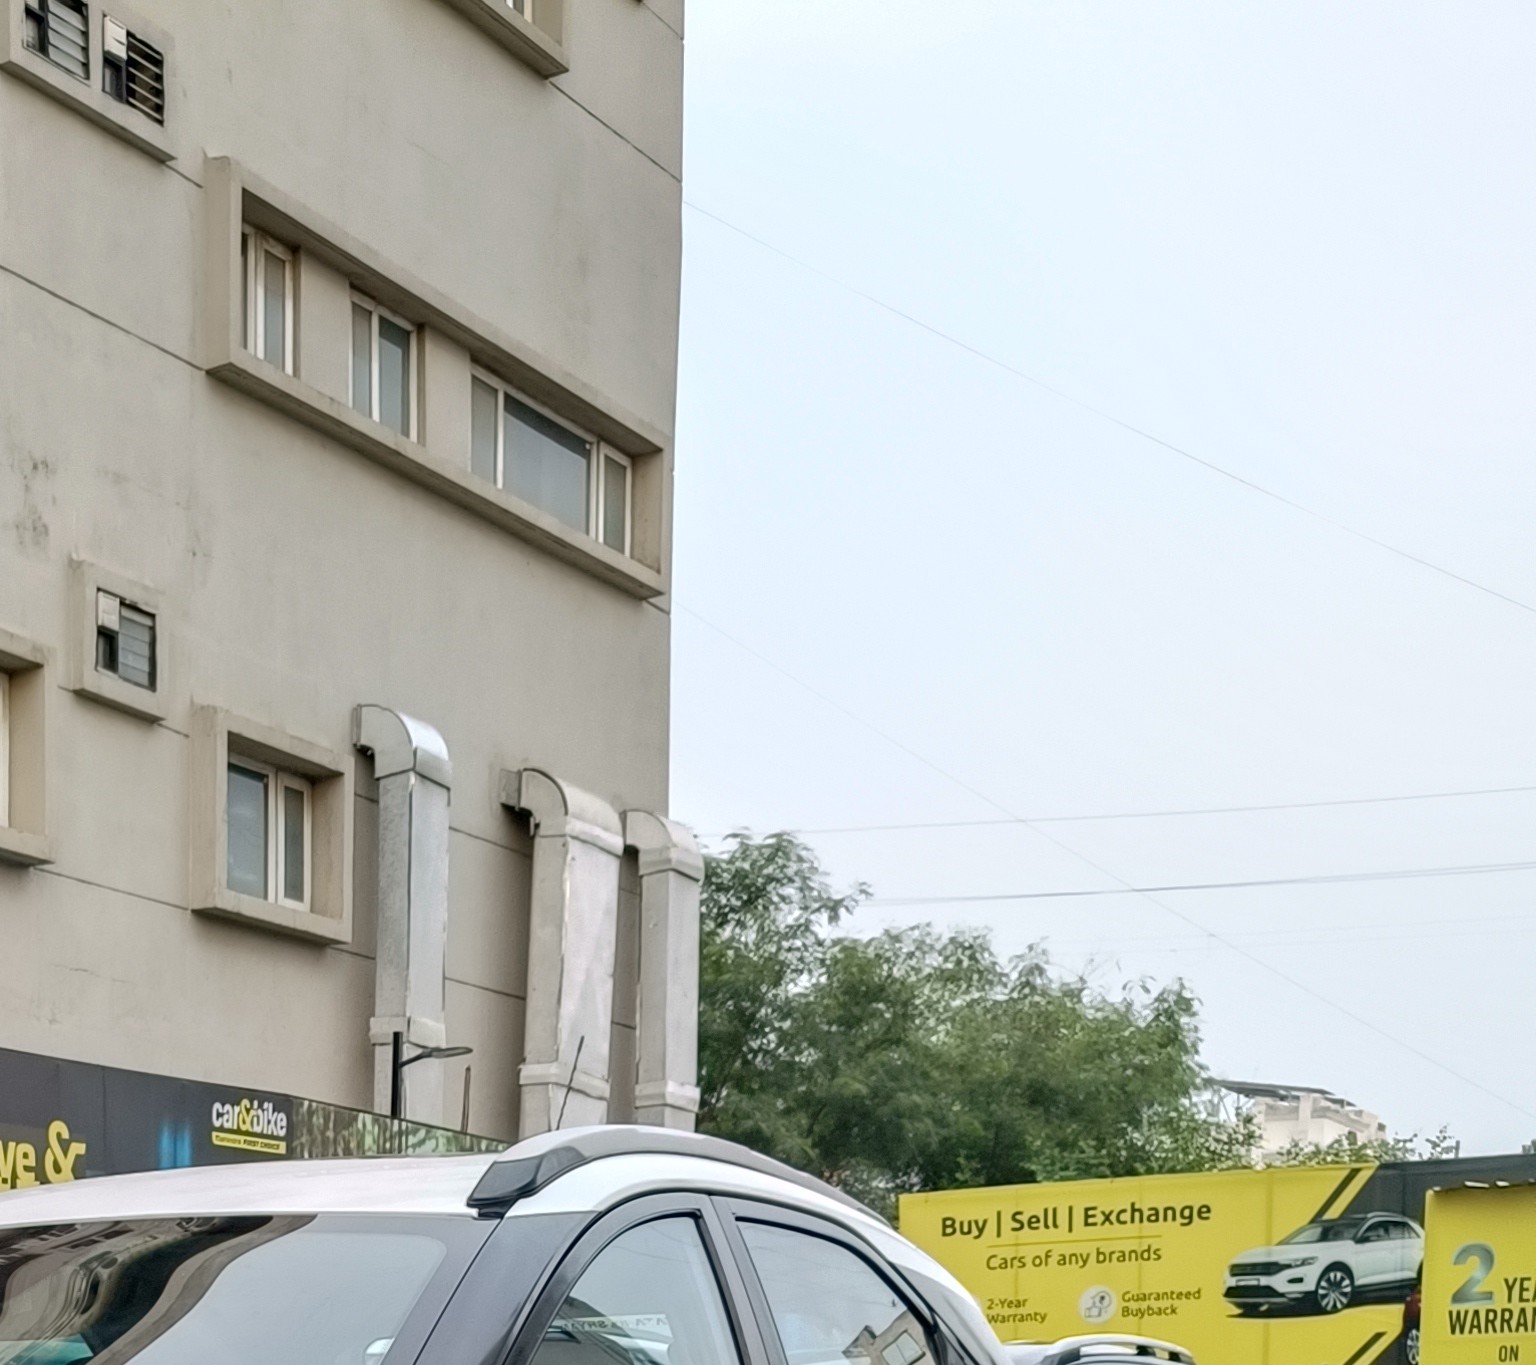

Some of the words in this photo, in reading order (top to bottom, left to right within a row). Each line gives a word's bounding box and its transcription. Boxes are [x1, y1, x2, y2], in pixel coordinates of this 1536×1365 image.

[212, 1098, 287, 1137] car&bike
[44, 1120, 86, 1184] &
[941, 1216, 989, 1240] Buy
[1010, 1207, 1059, 1232] Sell
[1083, 1202, 1212, 1227] Exchange
[986, 1254, 1027, 1271] Cars
[1032, 1250, 1053, 1268] of
[1056, 1251, 1090, 1269] any
[1096, 1244, 1162, 1265] brands
[1449, 1242, 1496, 1305] 2
[986, 1298, 1030, 1310] 2-Year
[1121, 1287, 1202, 1303] Guaranteed
[986, 1311, 1048, 1325] Warranty
[1121, 1304, 1178, 1320] Buyback
[1498, 1344, 1519, 1363] ON
